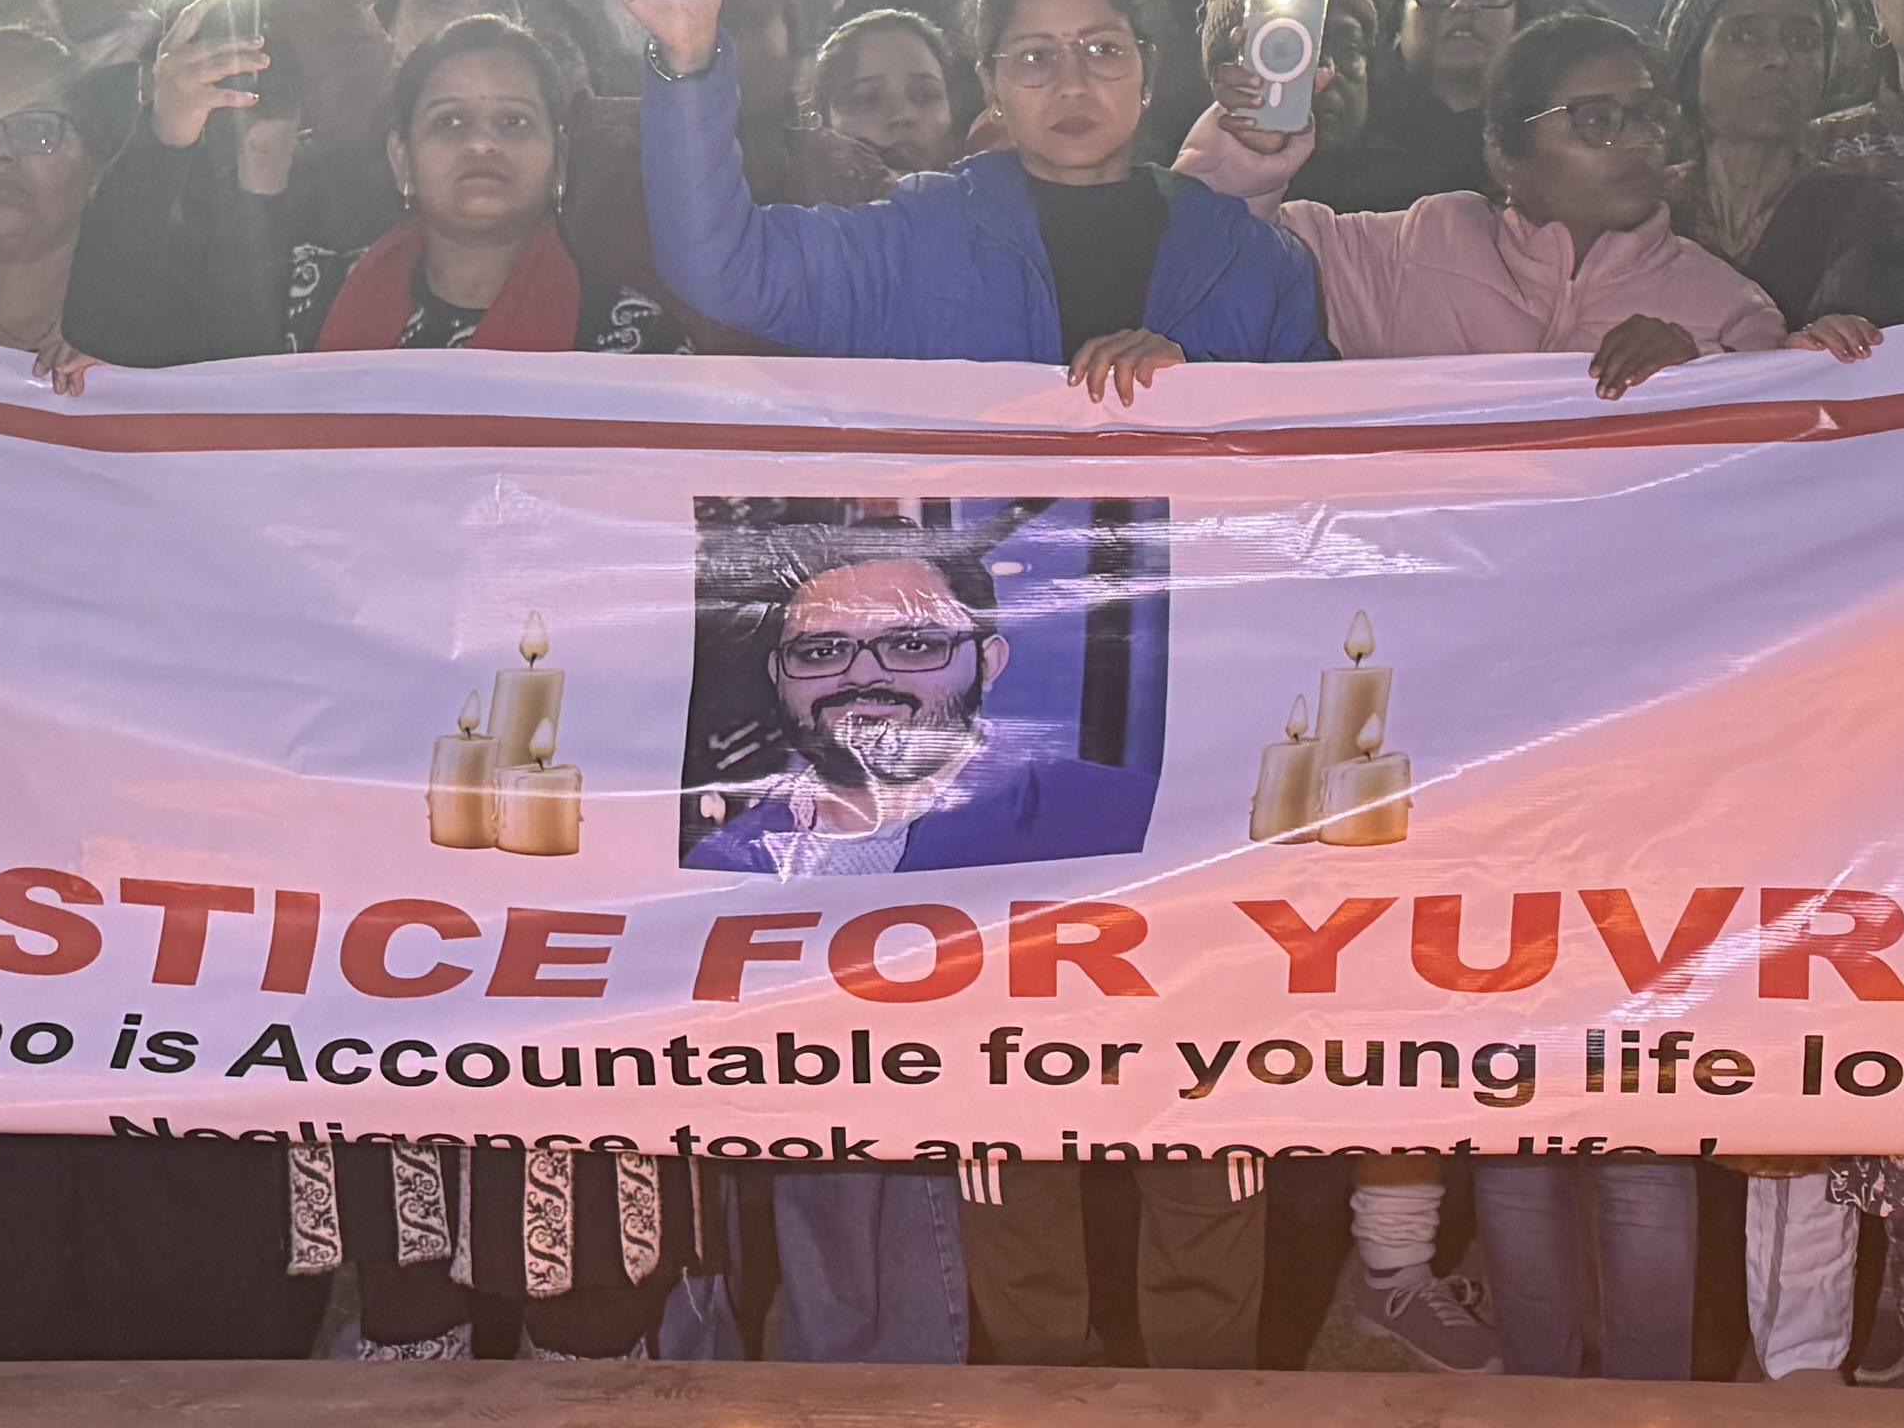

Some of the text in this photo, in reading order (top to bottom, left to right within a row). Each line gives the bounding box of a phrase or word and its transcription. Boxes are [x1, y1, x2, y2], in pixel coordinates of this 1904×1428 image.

[691, 900, 1160, 1004] FOR
[109, 1013, 199, 1075] is
[224, 1023, 943, 1089] Accountable
[979, 1025, 1143, 1086] for
[1176, 1039, 1538, 1109] young
[1585, 1028, 1755, 1097] life
[669, 1124, 880, 1161] took
[913, 1139, 1023, 1160] an
